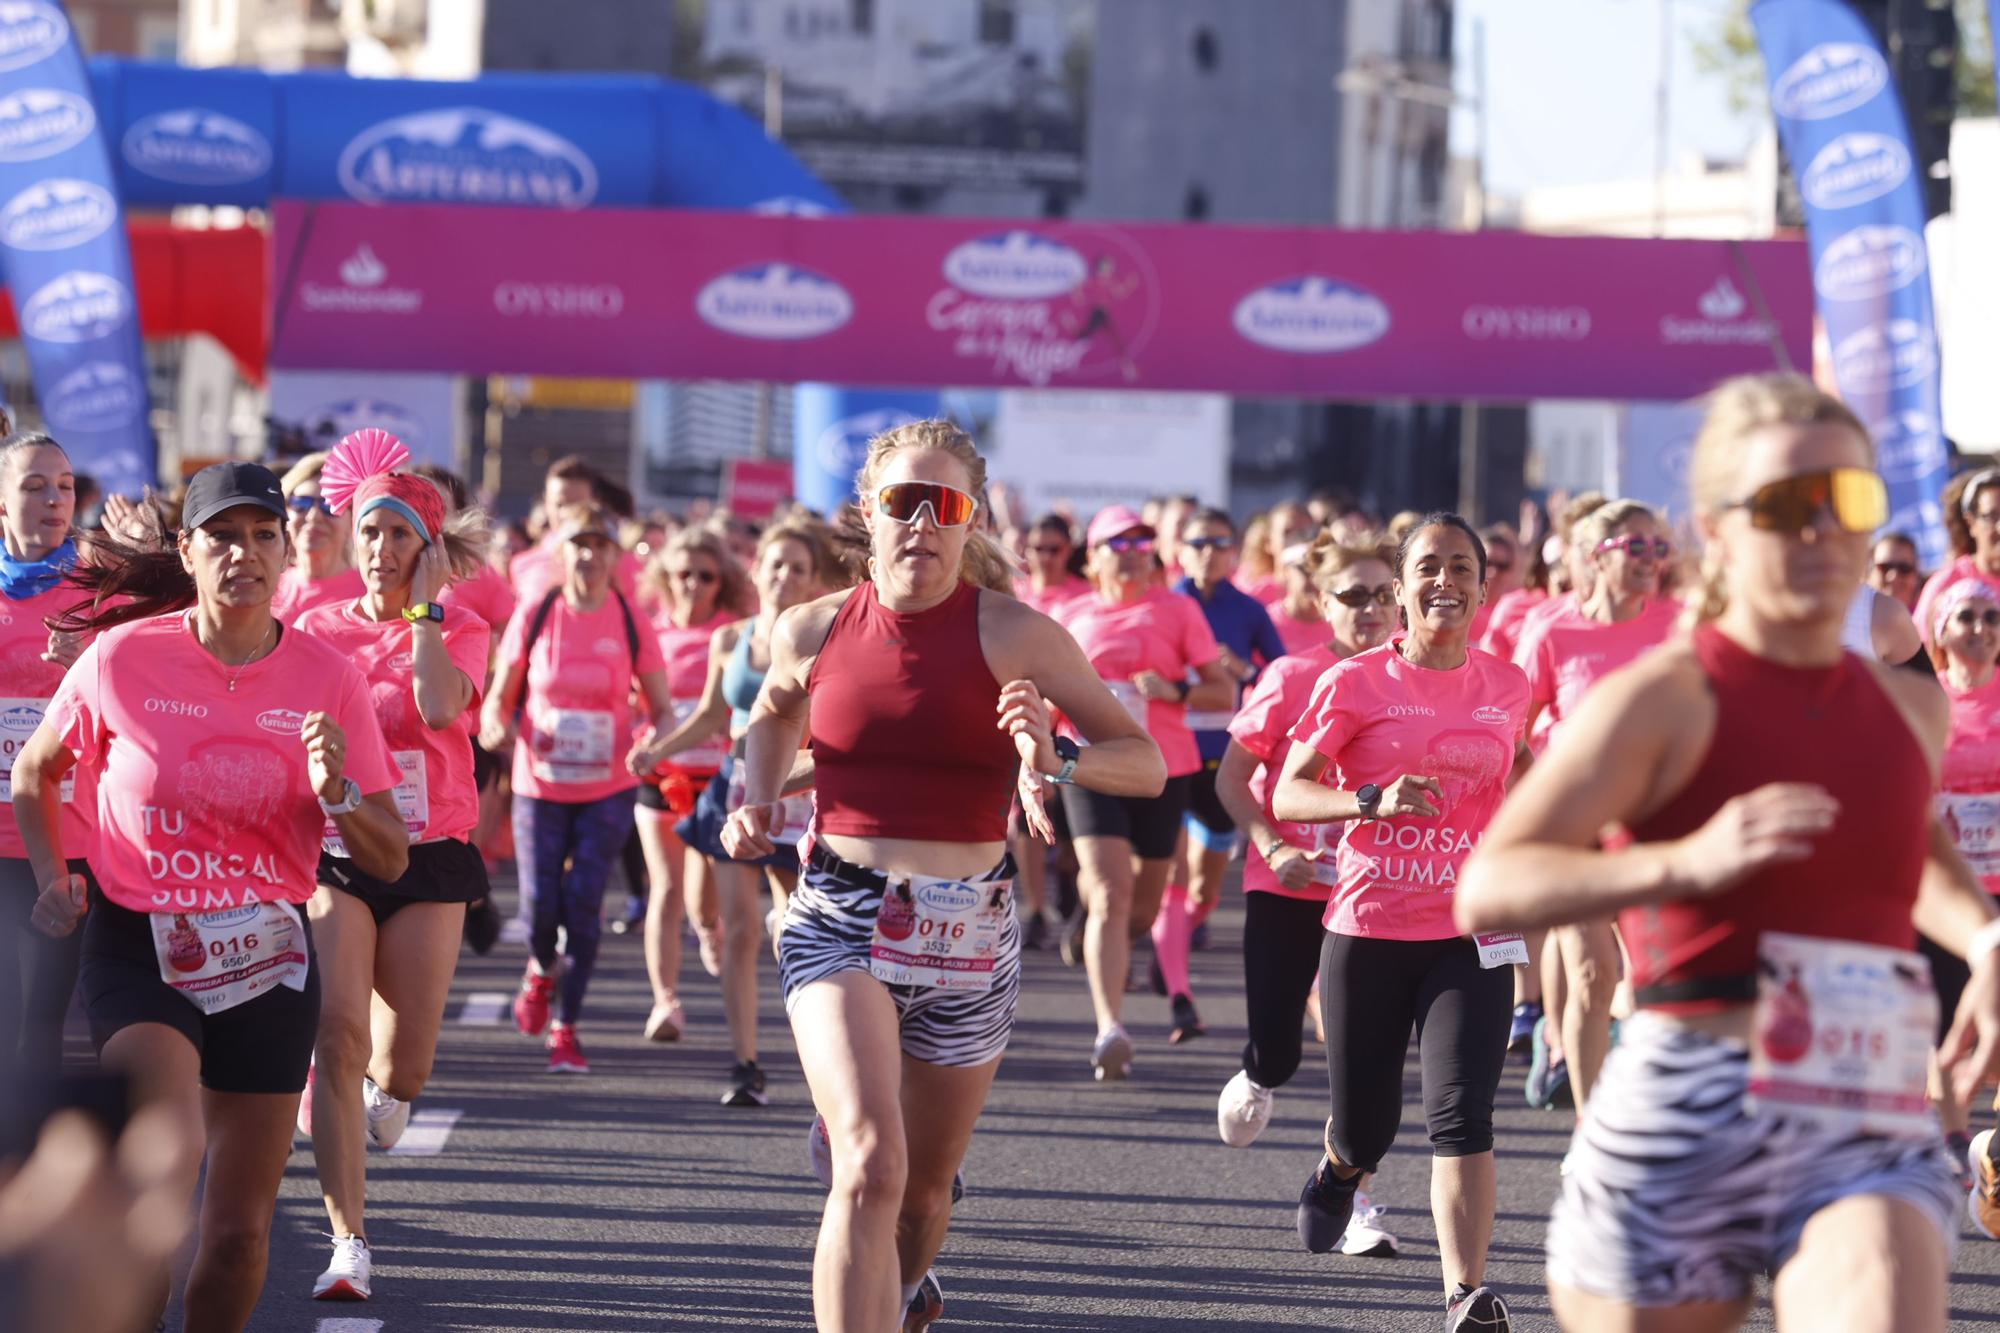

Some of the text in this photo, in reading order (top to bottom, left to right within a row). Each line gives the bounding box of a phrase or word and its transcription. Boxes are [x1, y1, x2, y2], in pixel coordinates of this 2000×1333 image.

[494, 281, 624, 318] OYSHO
[1462, 305, 1591, 341] OYSHO
[144, 698, 208, 719] OYSHO
[1387, 705, 1436, 717] OYSHO
[2, 715, 41, 726] ASTURIAN
[260, 715, 303, 730] ASTURIAN
[140, 805, 183, 836] TU
[146, 850, 285, 884] DORSAL
[1366, 856, 1457, 886] SUMA
[919, 919, 965, 939] 016
[209, 933, 259, 957] 016
[921, 940, 952, 954] 3532
[1490, 946, 1519, 960] OYSHO
[221, 953, 251, 969] 6500
[930, 958, 941, 966] LA
[944, 960, 970, 969] MUJER
[223, 972, 236, 983] DE
[236, 969, 247, 979] LA
[873, 967, 912, 982] OYSHO
[200, 992, 226, 1008] SHO
